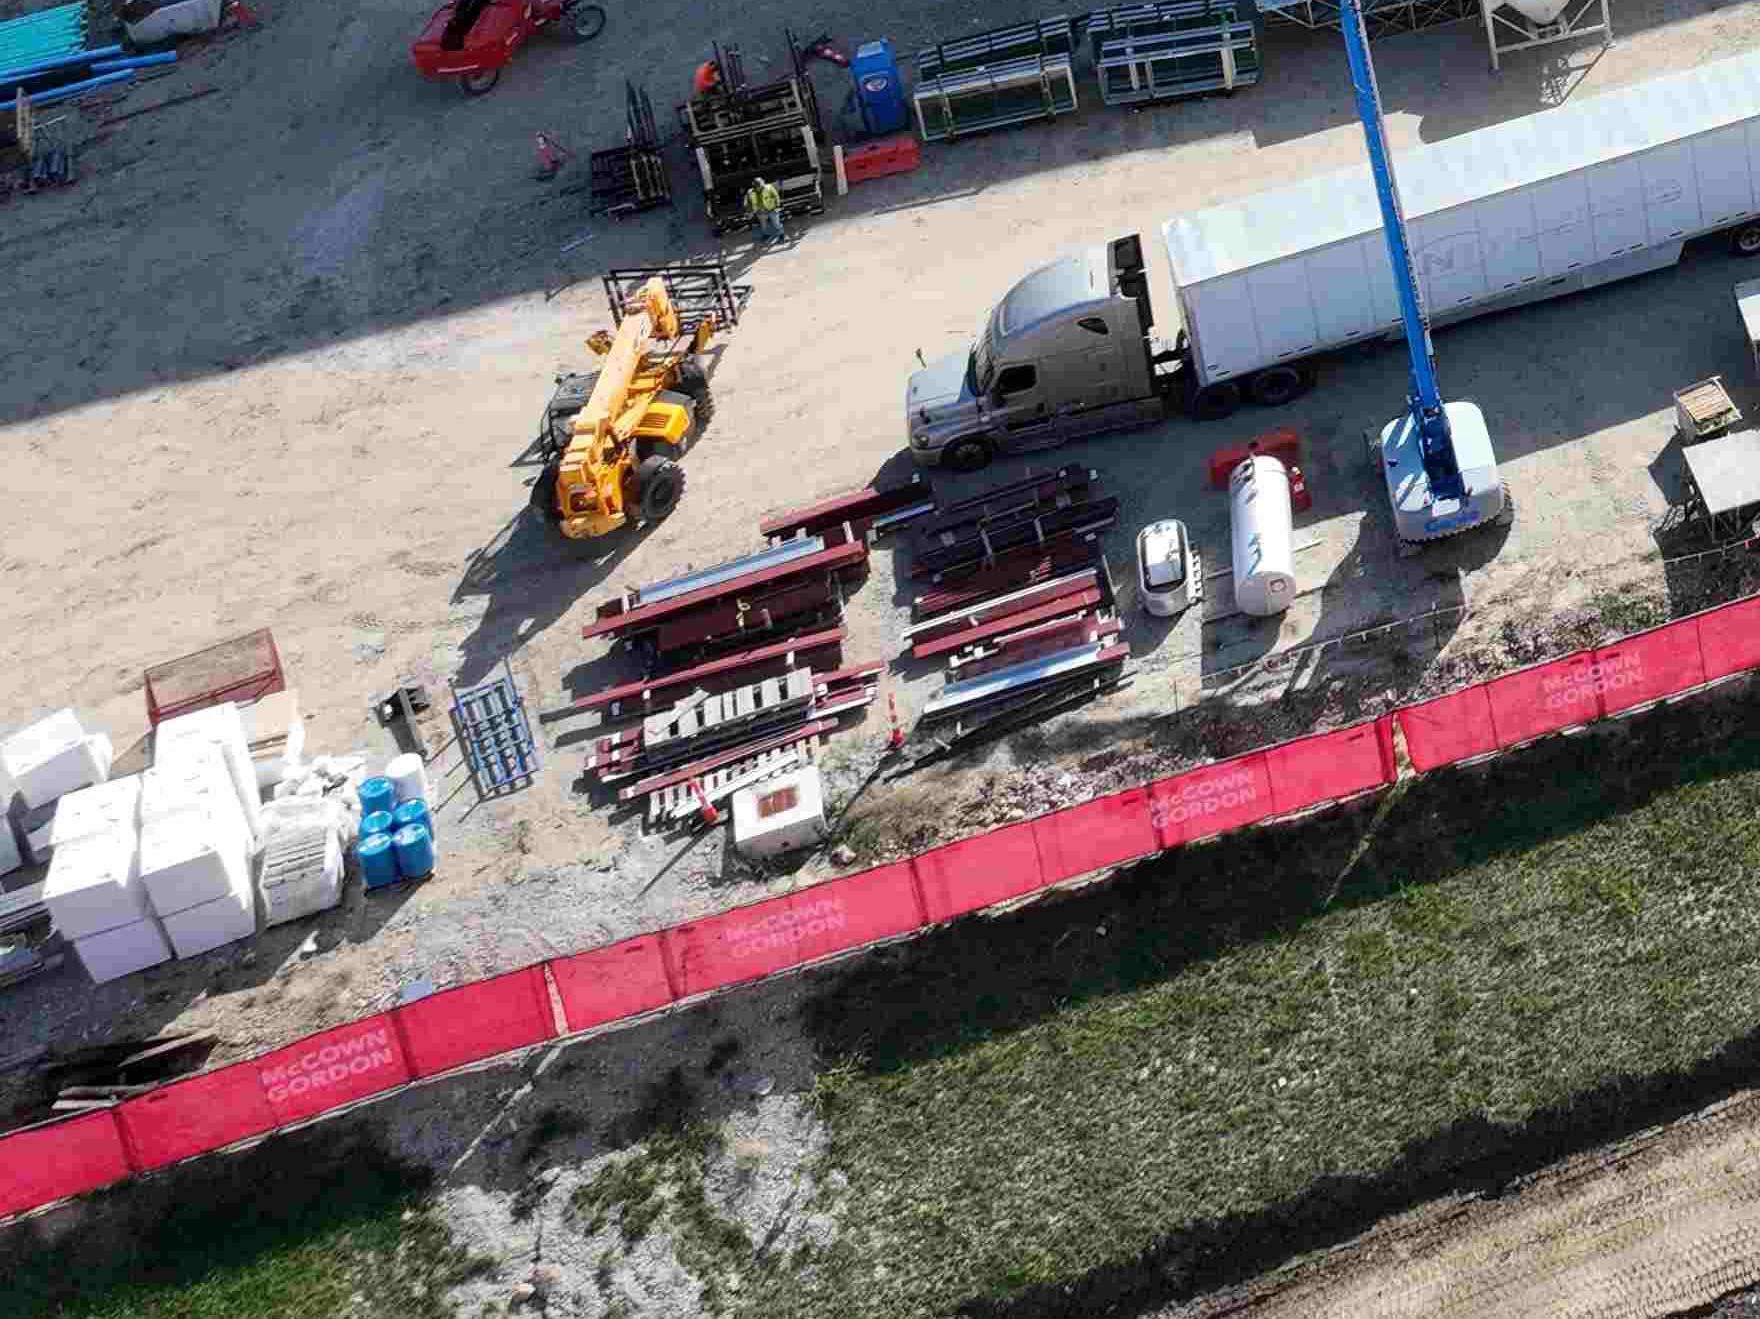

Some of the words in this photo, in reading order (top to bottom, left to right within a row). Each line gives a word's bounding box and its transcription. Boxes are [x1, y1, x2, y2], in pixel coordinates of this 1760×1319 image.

[1546, 666, 1644, 709] GORDON
[1150, 770, 1255, 815] McCOWN
[1152, 786, 1257, 829] GORDON
[262, 1028, 386, 1086] McCOWN
[268, 1047, 393, 1104] GORDON
